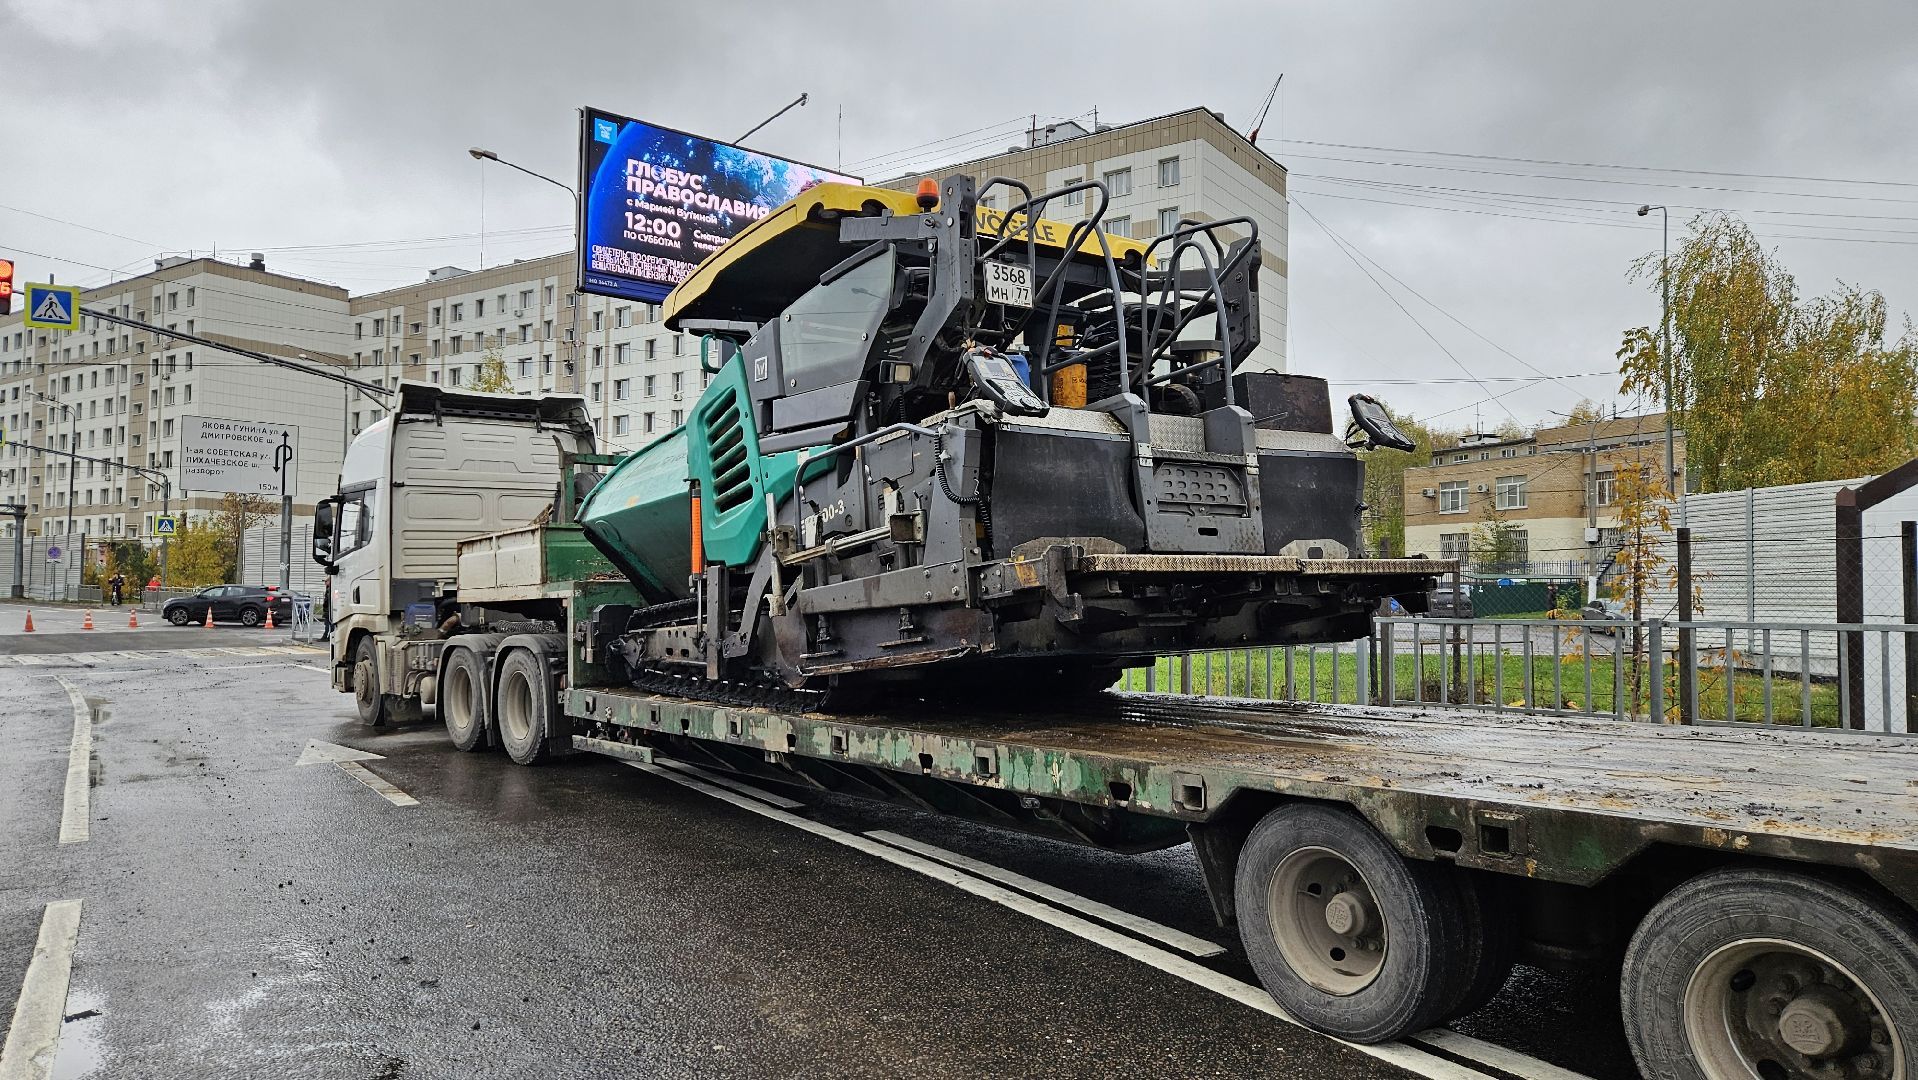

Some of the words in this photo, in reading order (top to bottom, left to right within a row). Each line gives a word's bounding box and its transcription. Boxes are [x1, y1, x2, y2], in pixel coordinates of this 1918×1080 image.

[627, 158, 703, 190] ГЛОБУС
[626, 175, 770, 220] ПРАВОСЛАВИЯ
[634, 199, 676, 215] Марией
[624, 211, 682, 238] 12:00
[623, 230, 638, 240] ПО
[637, 232, 681, 249] СУББОТАМ
[992, 264, 1026, 285] 3568
[991, 285, 1009, 301] МН
[1016, 287, 1029, 301] 77
[201, 421, 231, 431] ЯКОВА
[233, 424, 267, 434] ГУНИНА
[200, 431, 264, 443] ДМИТРОВСКОЕ
[185, 446, 204, 454] 1-ая
[206, 447, 258, 458] СОВЕТСКАЯ
[185, 456, 249, 468] ЛИХАЧЕВСКОЕ
[185, 468, 225, 477] разворот
